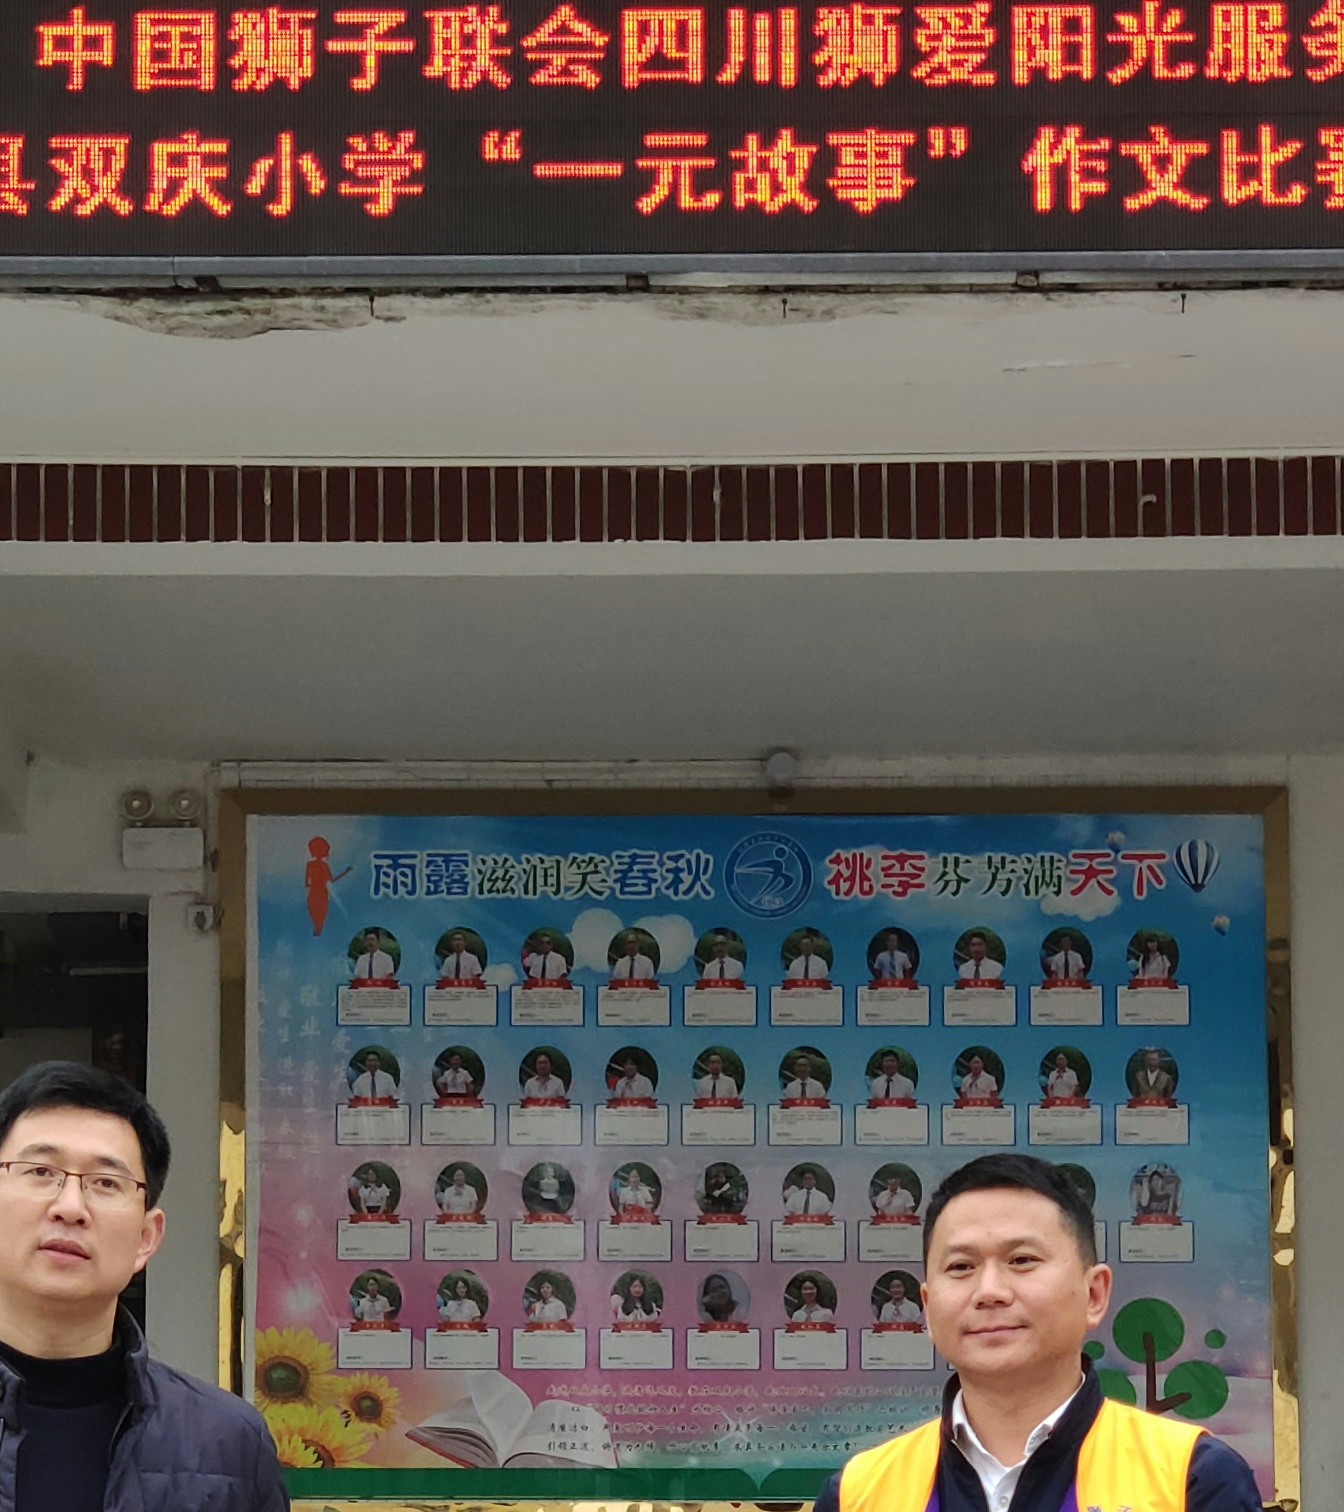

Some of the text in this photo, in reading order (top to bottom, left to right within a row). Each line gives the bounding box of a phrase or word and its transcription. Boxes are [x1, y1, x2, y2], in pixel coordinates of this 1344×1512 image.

[371, 849, 713, 898] 雨露滋润笑春秋
[826, 850, 1167, 898] 桃李芬芳满天下
